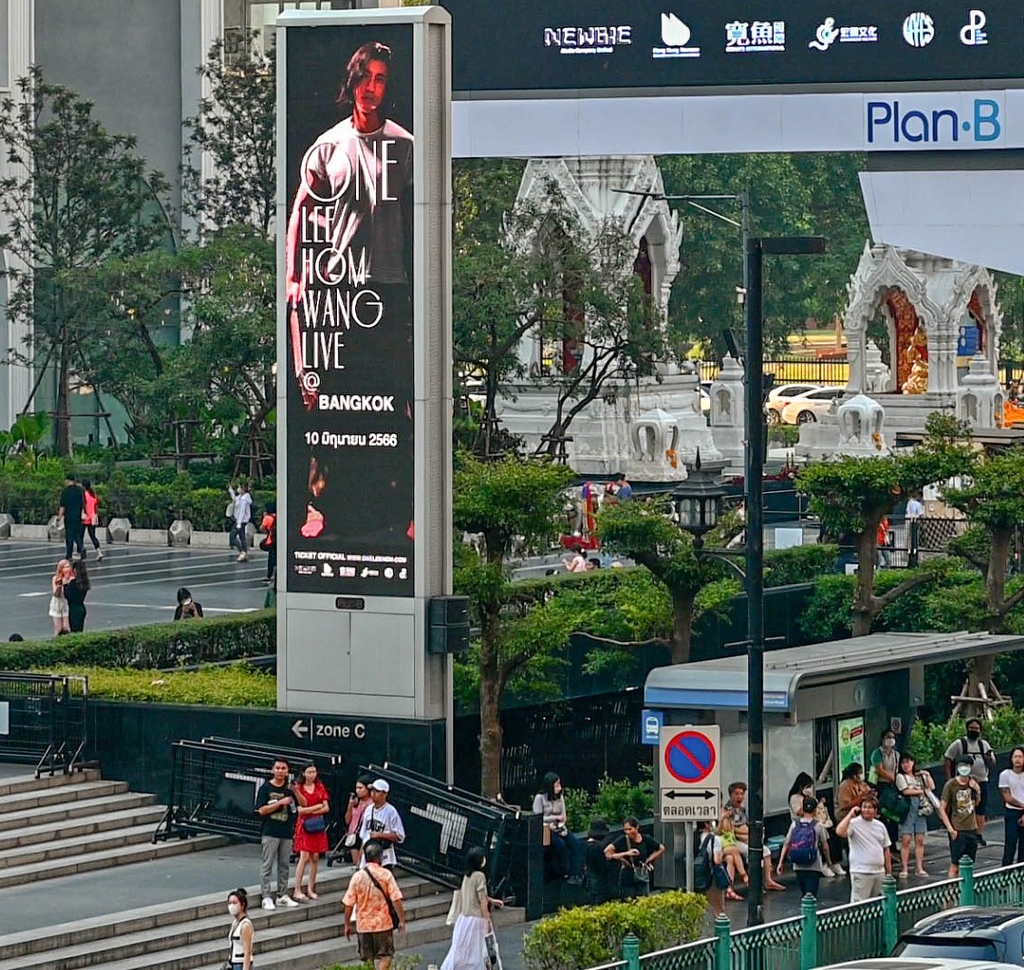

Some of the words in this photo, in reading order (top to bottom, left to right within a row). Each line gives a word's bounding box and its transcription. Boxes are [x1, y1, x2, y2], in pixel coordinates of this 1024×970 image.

[301, 139, 398, 208] ONE
[302, 205, 336, 244] LEE
[302, 246, 367, 288] HOM
[302, 289, 383, 328] WANG
[302, 332, 345, 370] LIVE
[303, 371, 320, 392] @
[318, 394, 395, 412] BANGKOK
[304, 431, 319, 445] 10
[368, 433, 398, 447] 2566
[316, 725, 350, 738] zone
[354, 723, 366, 738] C
[663, 805, 716, 816] ตลอดเวลา
